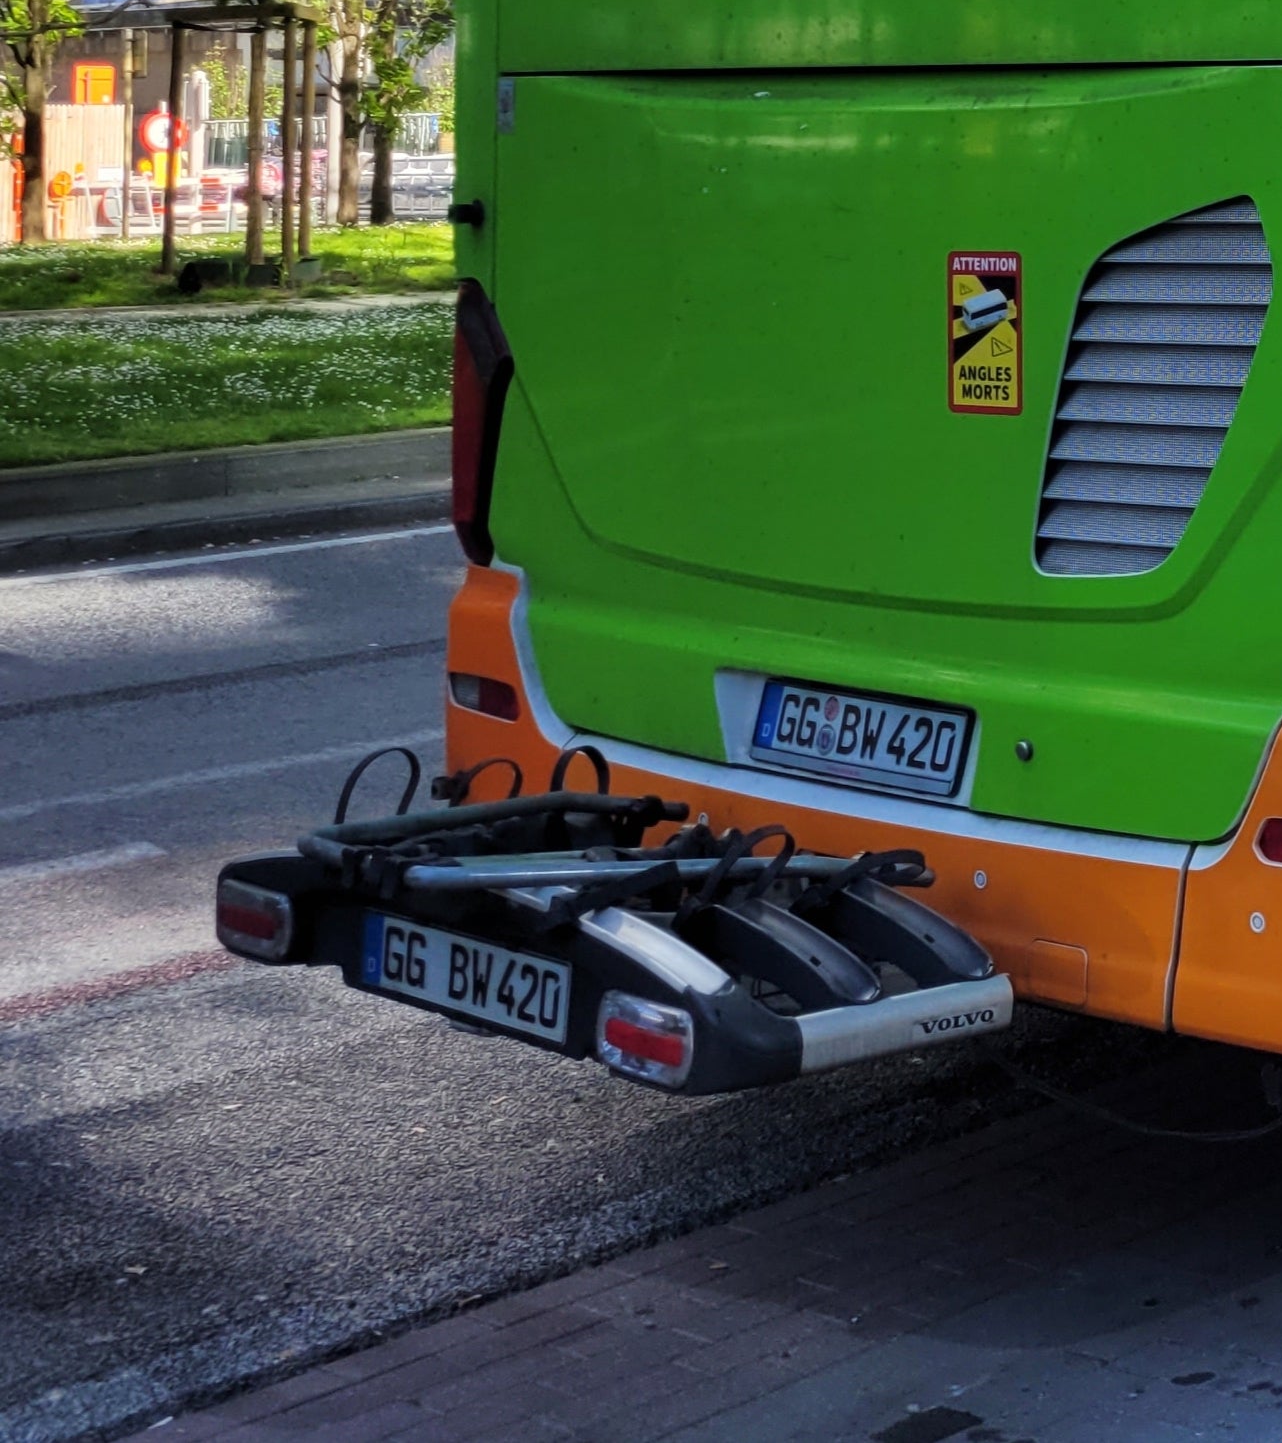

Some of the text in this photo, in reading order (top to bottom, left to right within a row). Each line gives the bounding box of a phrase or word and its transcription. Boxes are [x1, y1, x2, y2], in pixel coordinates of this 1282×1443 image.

[953, 257, 1017, 272] ATTENTION
[958, 365, 1012, 383] ANGLES
[962, 384, 1010, 401] MORTS
[761, 724, 771, 738] D
[776, 694, 957, 773] GG BW 420
[383, 926, 561, 1029] GG BW 420
[921, 1009, 994, 1034] VOLVO
